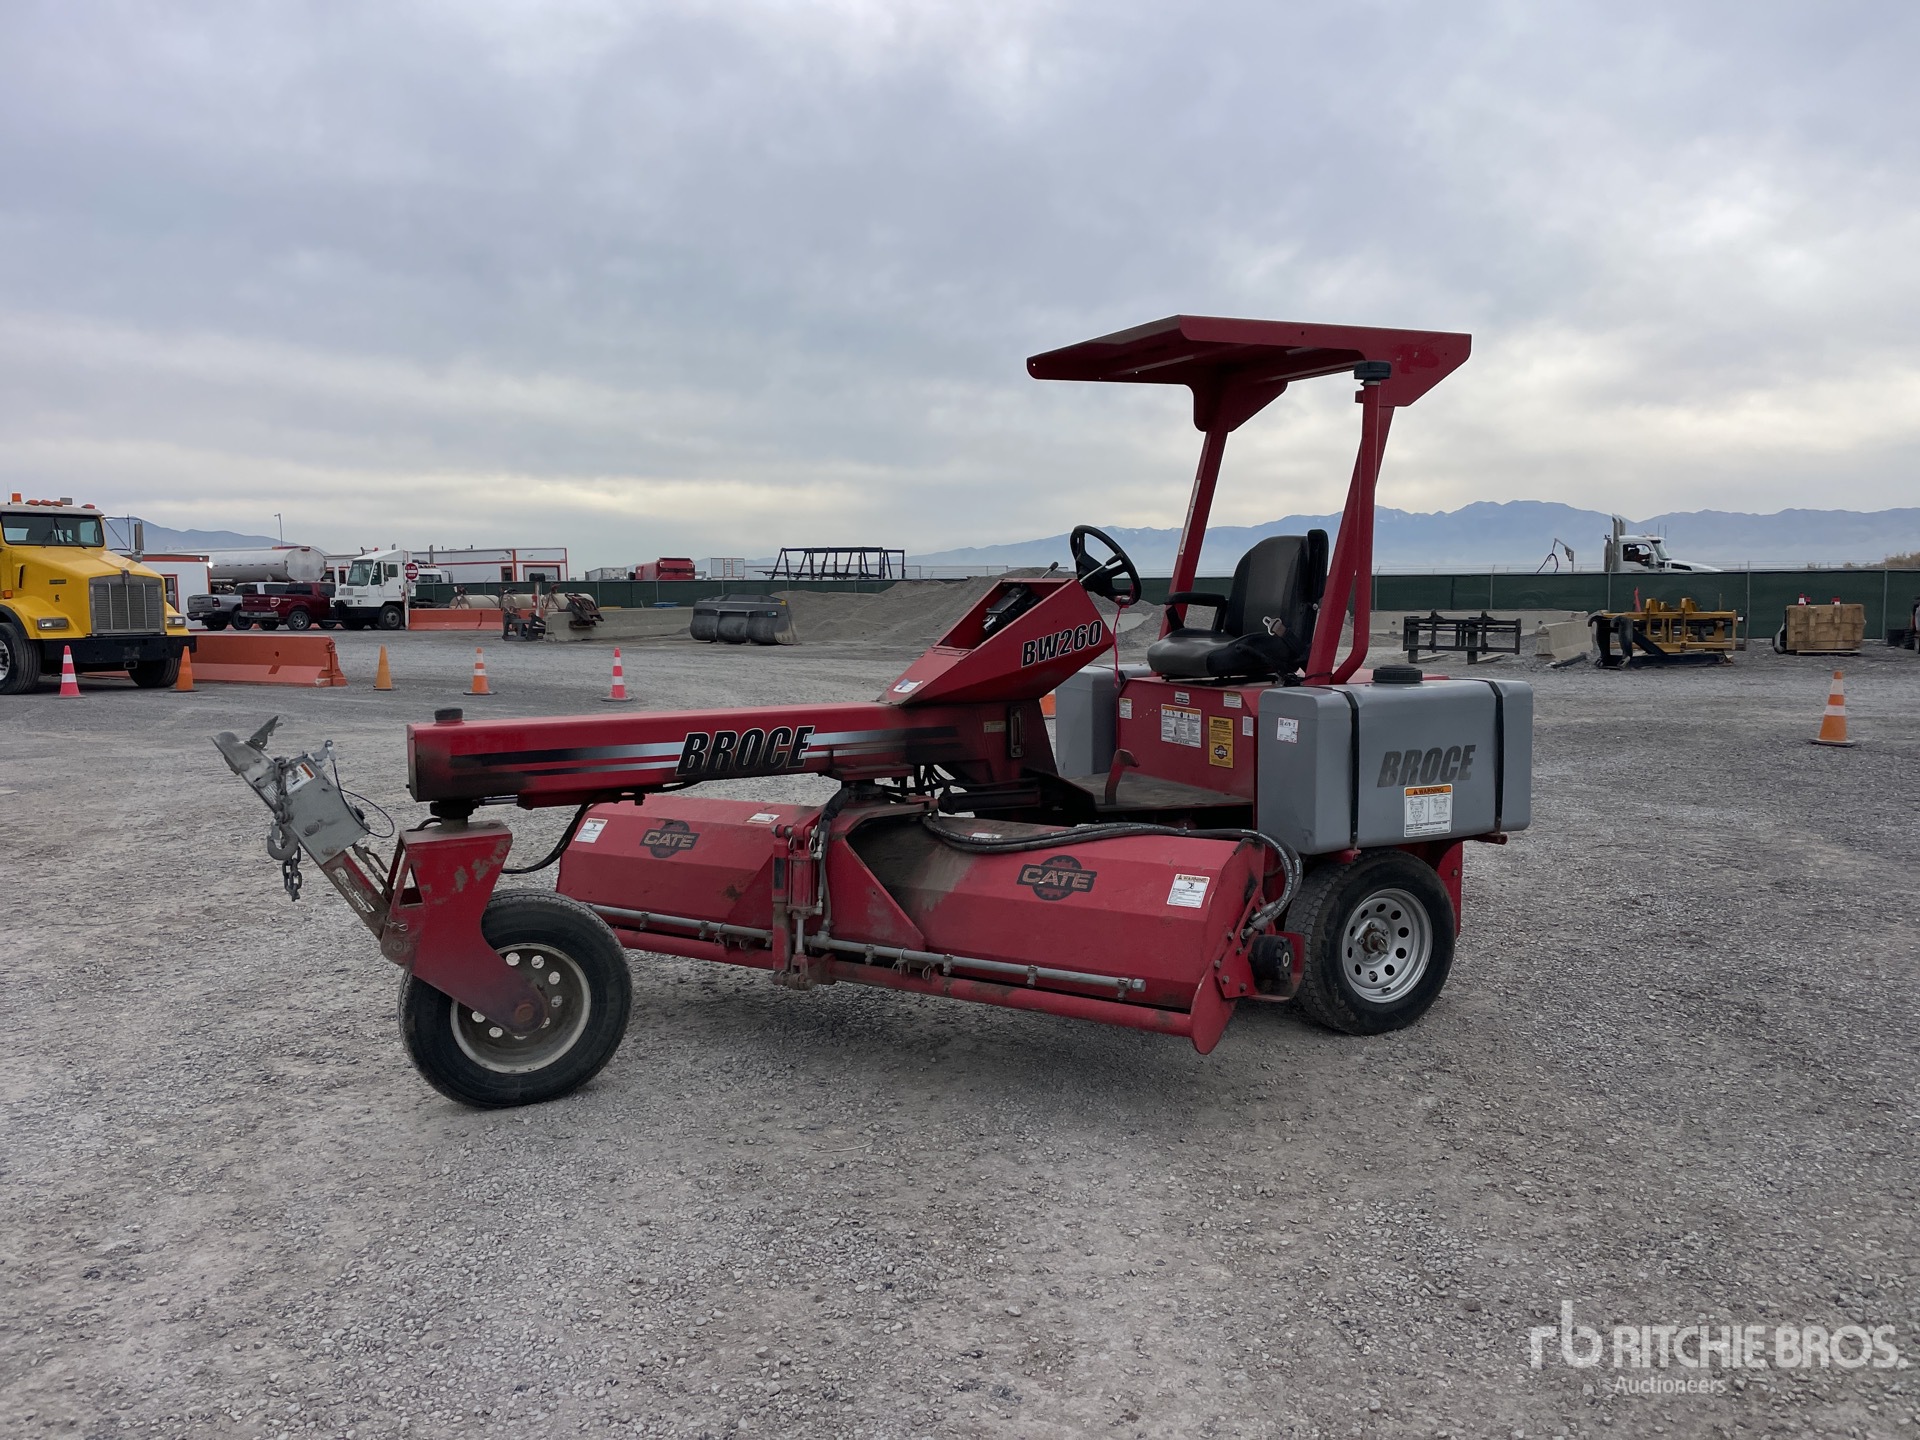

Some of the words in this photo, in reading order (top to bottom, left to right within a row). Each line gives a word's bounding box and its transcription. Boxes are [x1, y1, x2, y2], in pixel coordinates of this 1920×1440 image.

[1021, 620, 1102, 668] BW260
[675, 725, 815, 776] BROCE
[1377, 745, 1476, 787] BROCE
[643, 831, 695, 848] CATE
[1022, 867, 1092, 889] CATE
